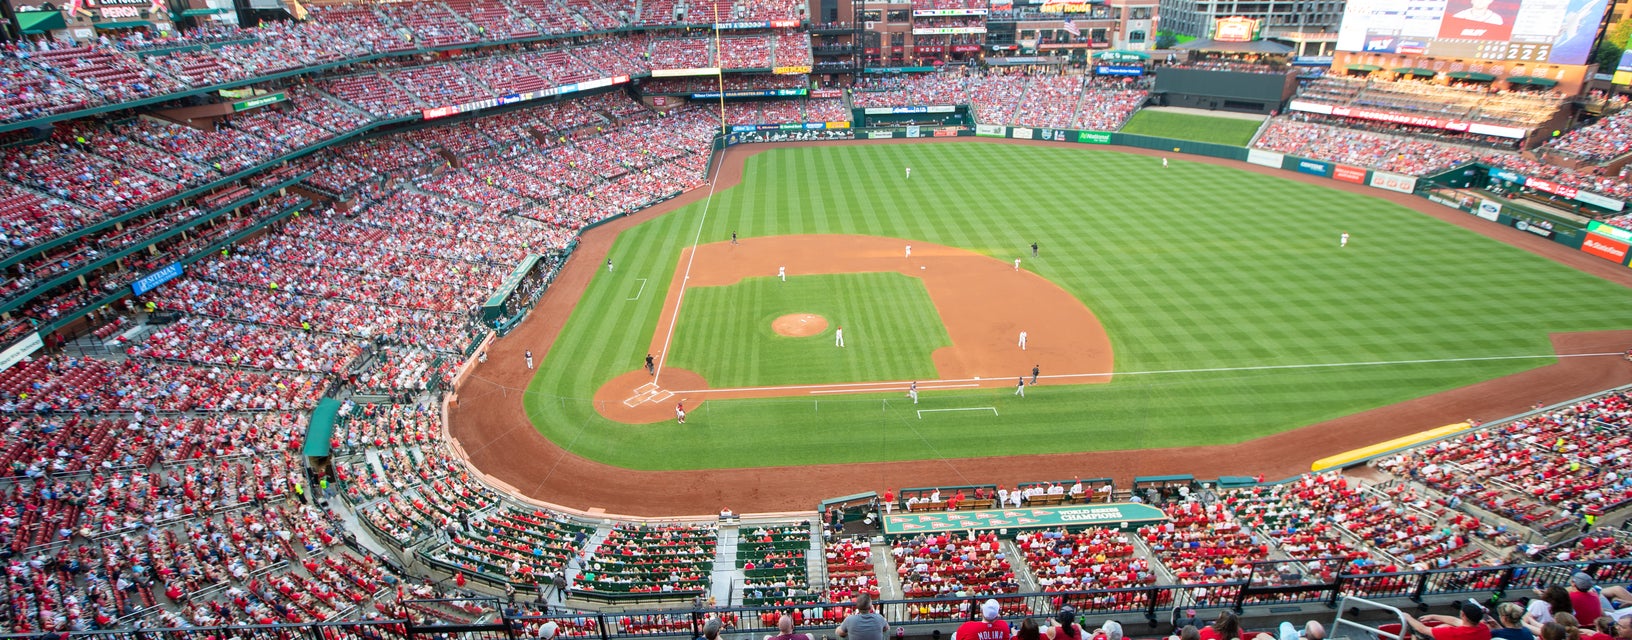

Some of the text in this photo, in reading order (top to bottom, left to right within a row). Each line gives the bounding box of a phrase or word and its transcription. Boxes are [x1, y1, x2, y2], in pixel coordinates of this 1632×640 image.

[100, 7, 139, 19] PERCH
[1040, 3, 1092, 13] BREW HOUSE
[1506, 48, 1548, 61] 2 2 2
[1359, 110, 1410, 123] SCOREBOARD
[1411, 117, 1437, 127] PATIO
[147, 264, 176, 282] SITEMAN
[1060, 511, 1123, 521] CHAMPIONS
[977, 630, 1004, 640] MOLINA
